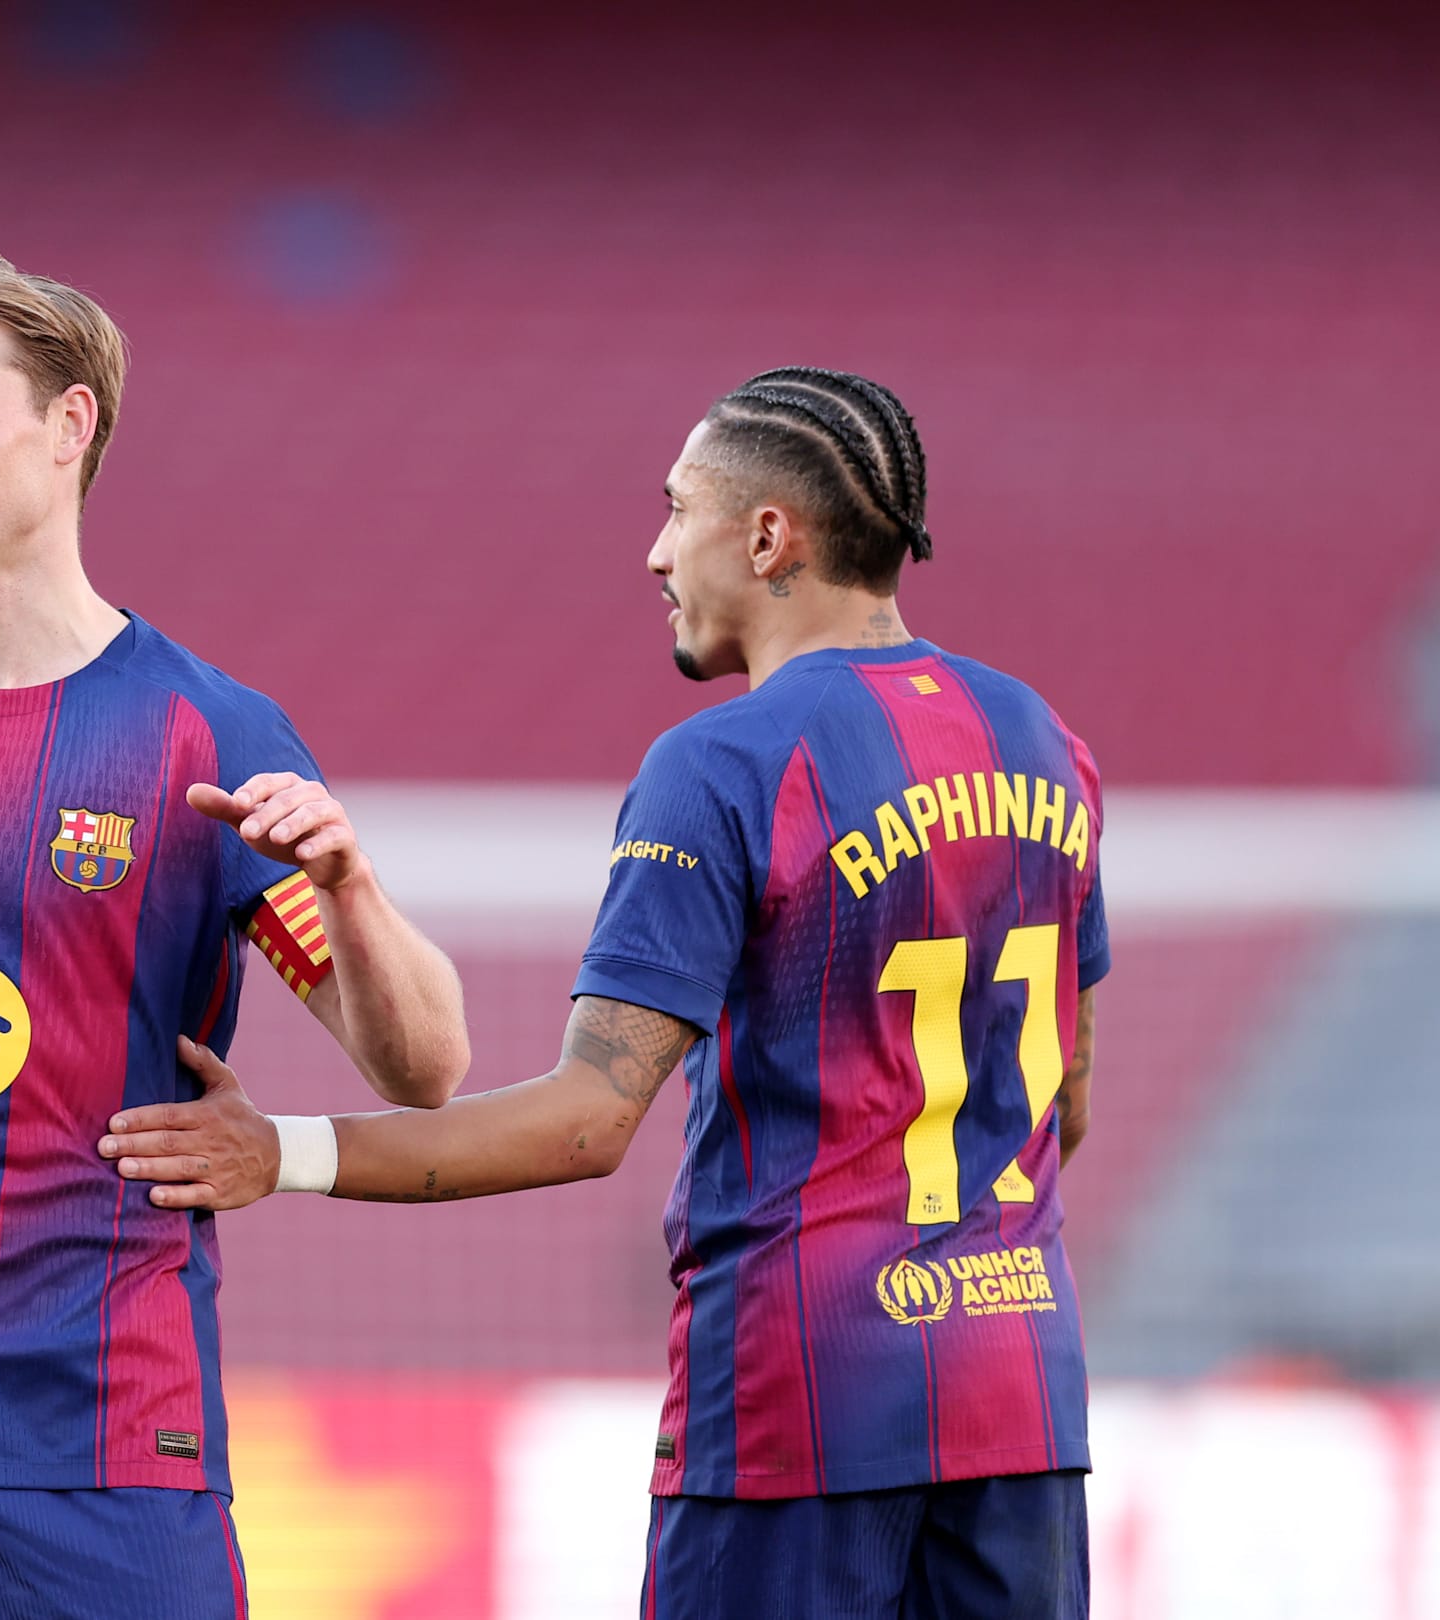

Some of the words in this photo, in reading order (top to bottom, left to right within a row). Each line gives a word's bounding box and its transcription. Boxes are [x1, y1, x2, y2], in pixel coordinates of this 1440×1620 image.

[829, 771, 1089, 899] RAPHINHA
[677, 850, 699, 869] tv
[877, 923, 1065, 1225] 11
[947, 1246, 1045, 1280] UNHCR
[962, 1273, 1054, 1306] ACNUR
